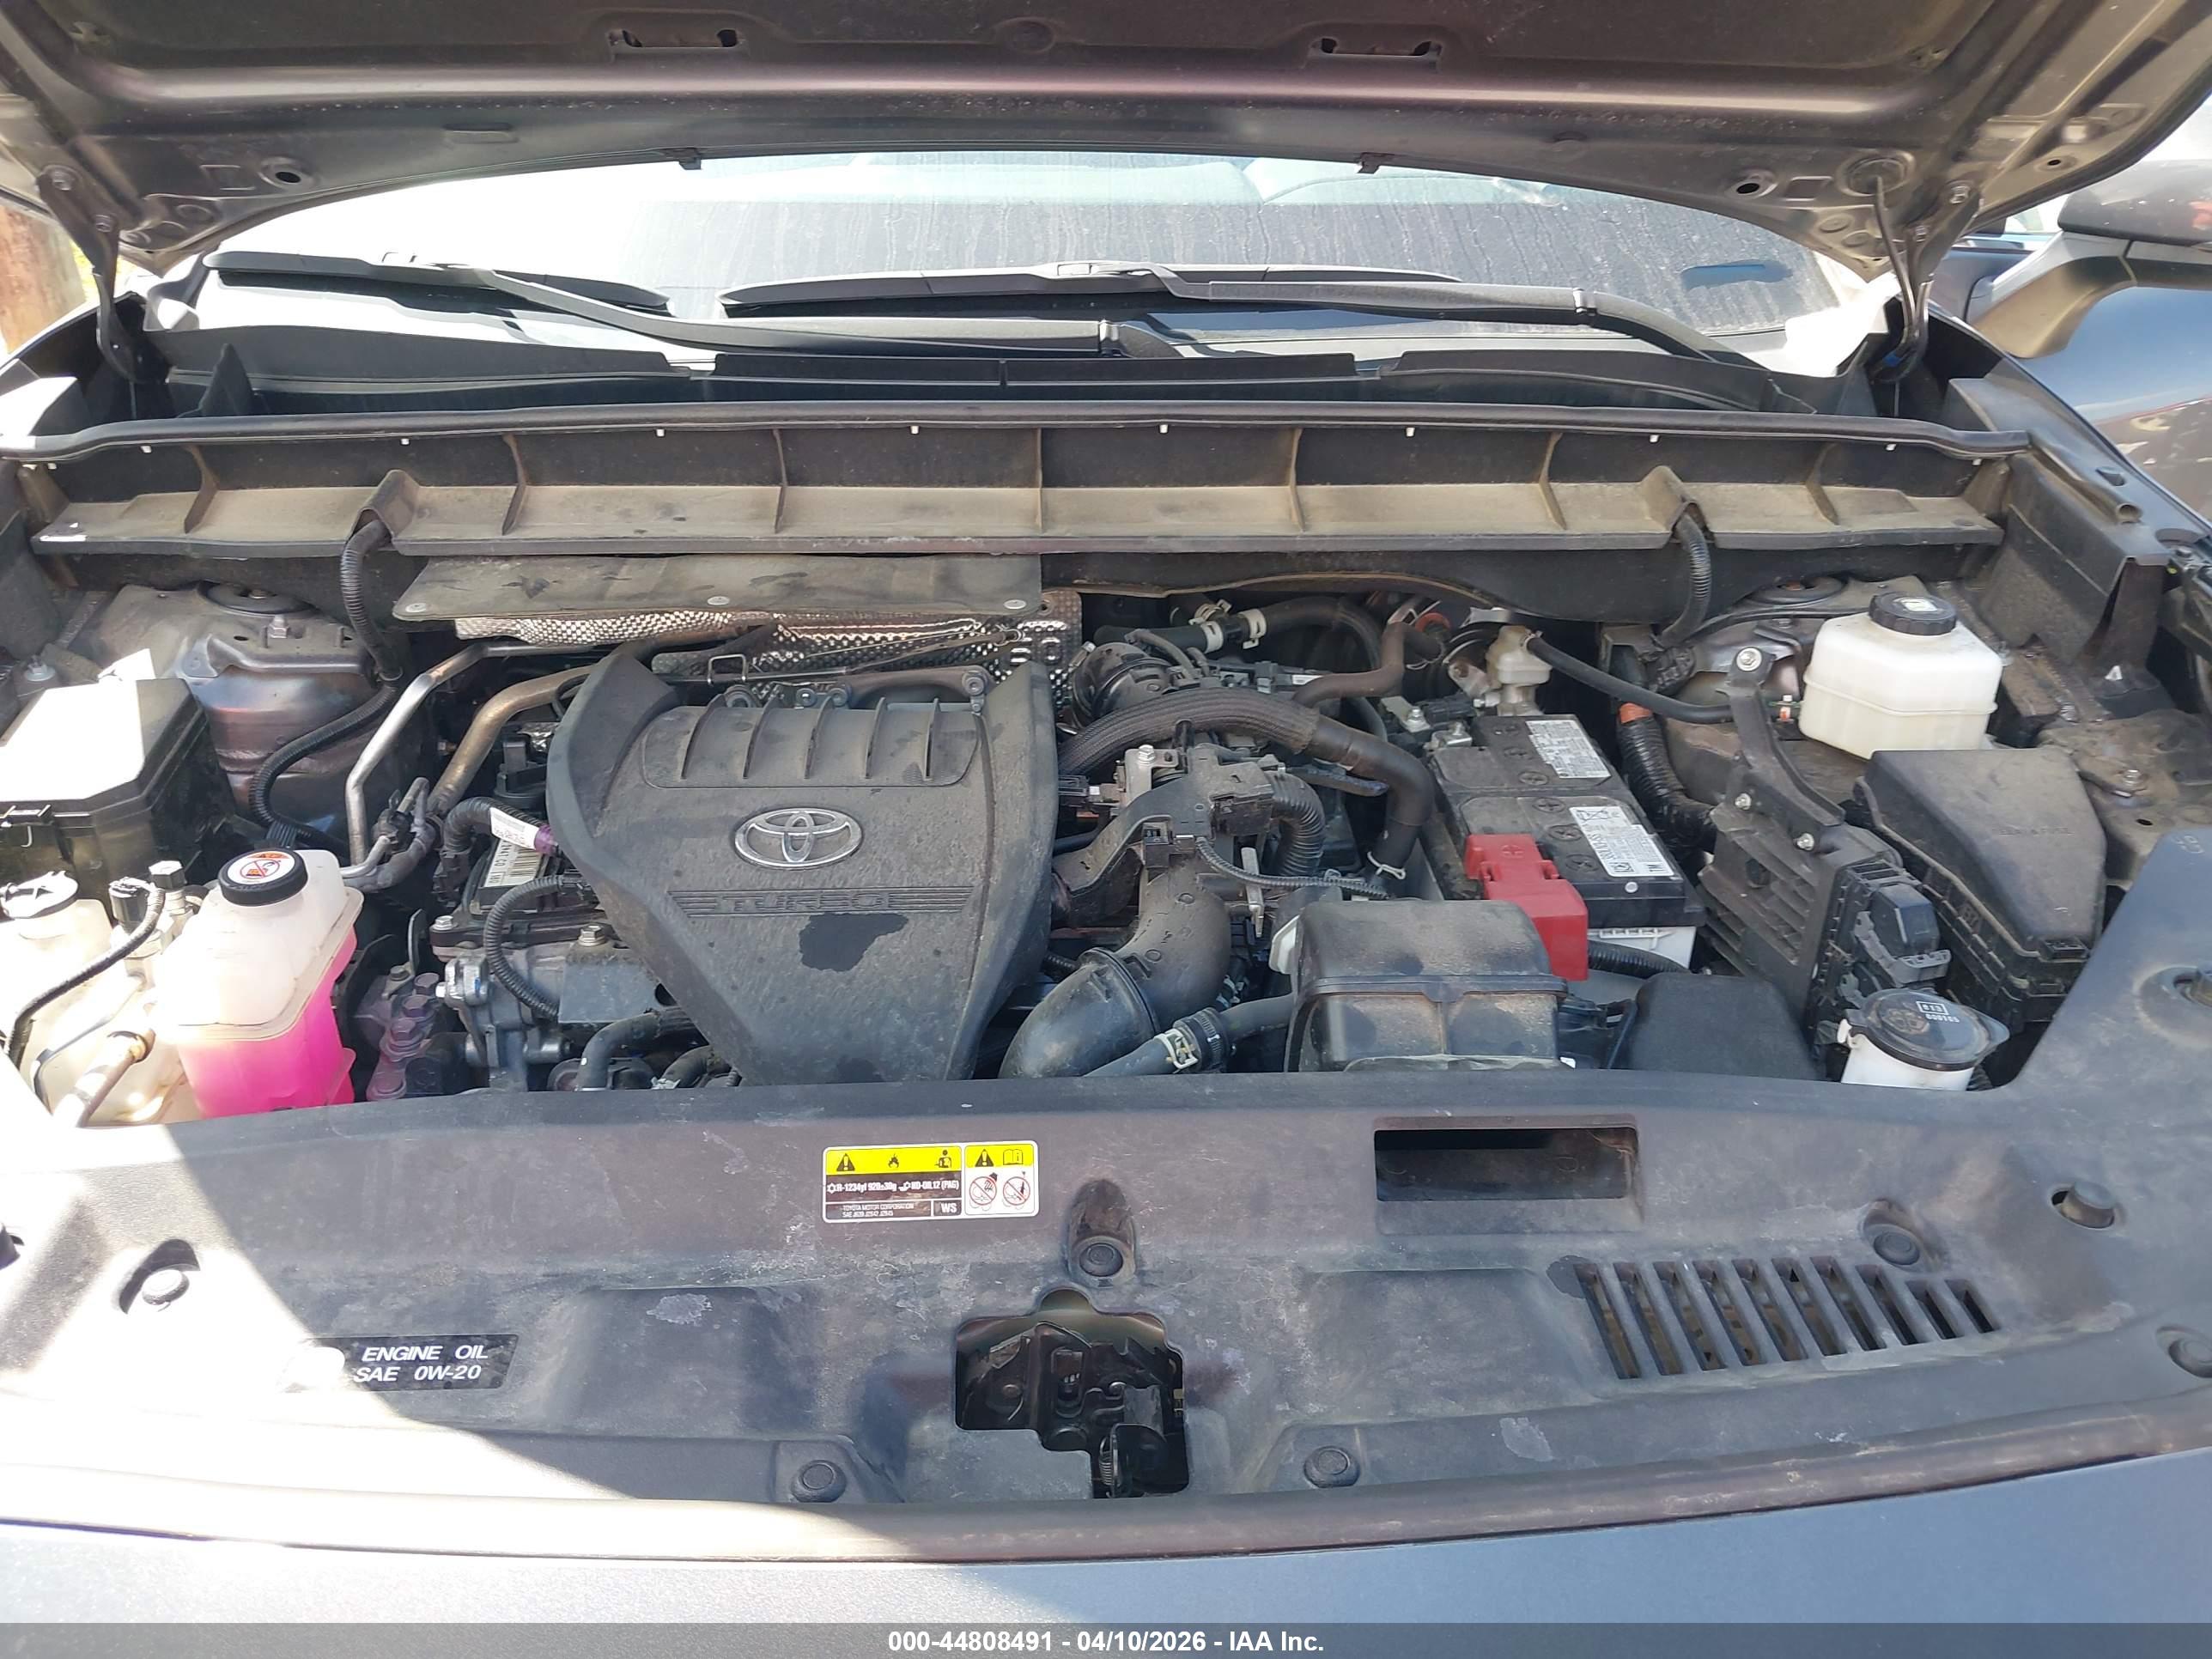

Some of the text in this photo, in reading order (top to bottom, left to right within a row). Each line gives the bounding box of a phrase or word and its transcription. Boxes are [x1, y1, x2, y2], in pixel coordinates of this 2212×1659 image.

[722, 892, 882, 913] TURBO
[941, 1203, 957, 1213] WS
[362, 1345, 489, 1362] ENGINE OIL
[353, 1364, 482, 1382] SAE 0W-20
